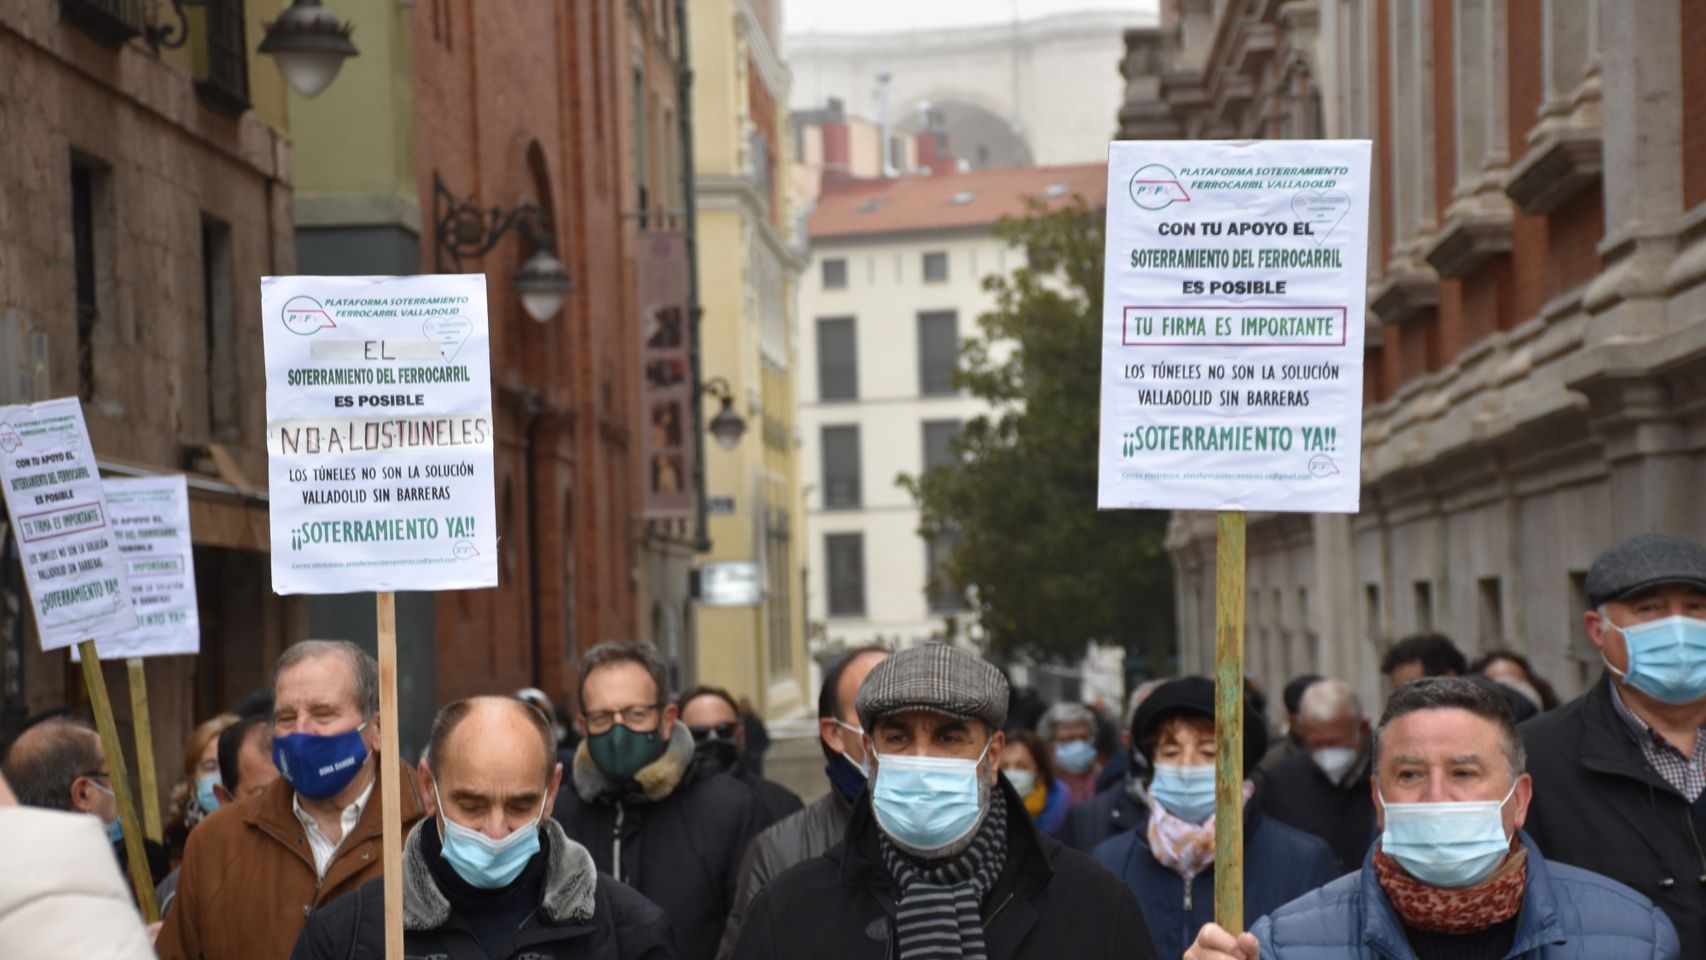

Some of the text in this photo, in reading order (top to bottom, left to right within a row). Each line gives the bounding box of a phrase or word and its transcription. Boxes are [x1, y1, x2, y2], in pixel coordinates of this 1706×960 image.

[1180, 166, 1348, 177] PLATAFORMA SOTERRAMIENTO
[1190, 180, 1337, 190] FERROCARRIL VALLADOLID
[1158, 222, 1315, 236] CON TU APOYO EL
[1131, 249, 1342, 269] SOTERRAMIENTO DEL FERROCARRIL
[1183, 280, 1287, 294] ES POSIBLE
[324, 296, 469, 307] PLATAFORMA SOTERRAMIENTO
[335, 307, 460, 318] FERROCARRIL VALLADOLID
[1135, 317, 1334, 337] TU FIRMA ES IMPORTANTE
[364, 340, 396, 360] EL
[288, 365, 470, 386] SOTERRAMIENTO DEL FERROCARRIL
[1125, 360, 1339, 380] LOS TÚNELES NO SON LA SOLUCIÓN
[334, 395, 424, 408] ES POSIBLE
[1138, 390, 1310, 406] VALLADOLID SIN BARRERAS
[1123, 426, 1336, 457] ¡¡SOTERRAMIENTO YA!!
[16, 451, 74, 469] CON TU APOYO EL
[289, 460, 474, 482] LOS TÚNELES NO SON LA SOLUCIÓN
[35, 489, 74, 505] ES POSIBLE
[302, 486, 451, 504] VALLADOLID SIN BARRERAS
[34, 519, 51, 533] FIRMA
[53, 516, 61, 529] ES
[63, 509, 99, 527] IMPORTANTE
[291, 516, 475, 551] ¡¡SOTERRAMIENTO YA!!
[59, 548, 66, 557] NO
[67, 545, 77, 556] SON
[78, 544, 85, 553] LA
